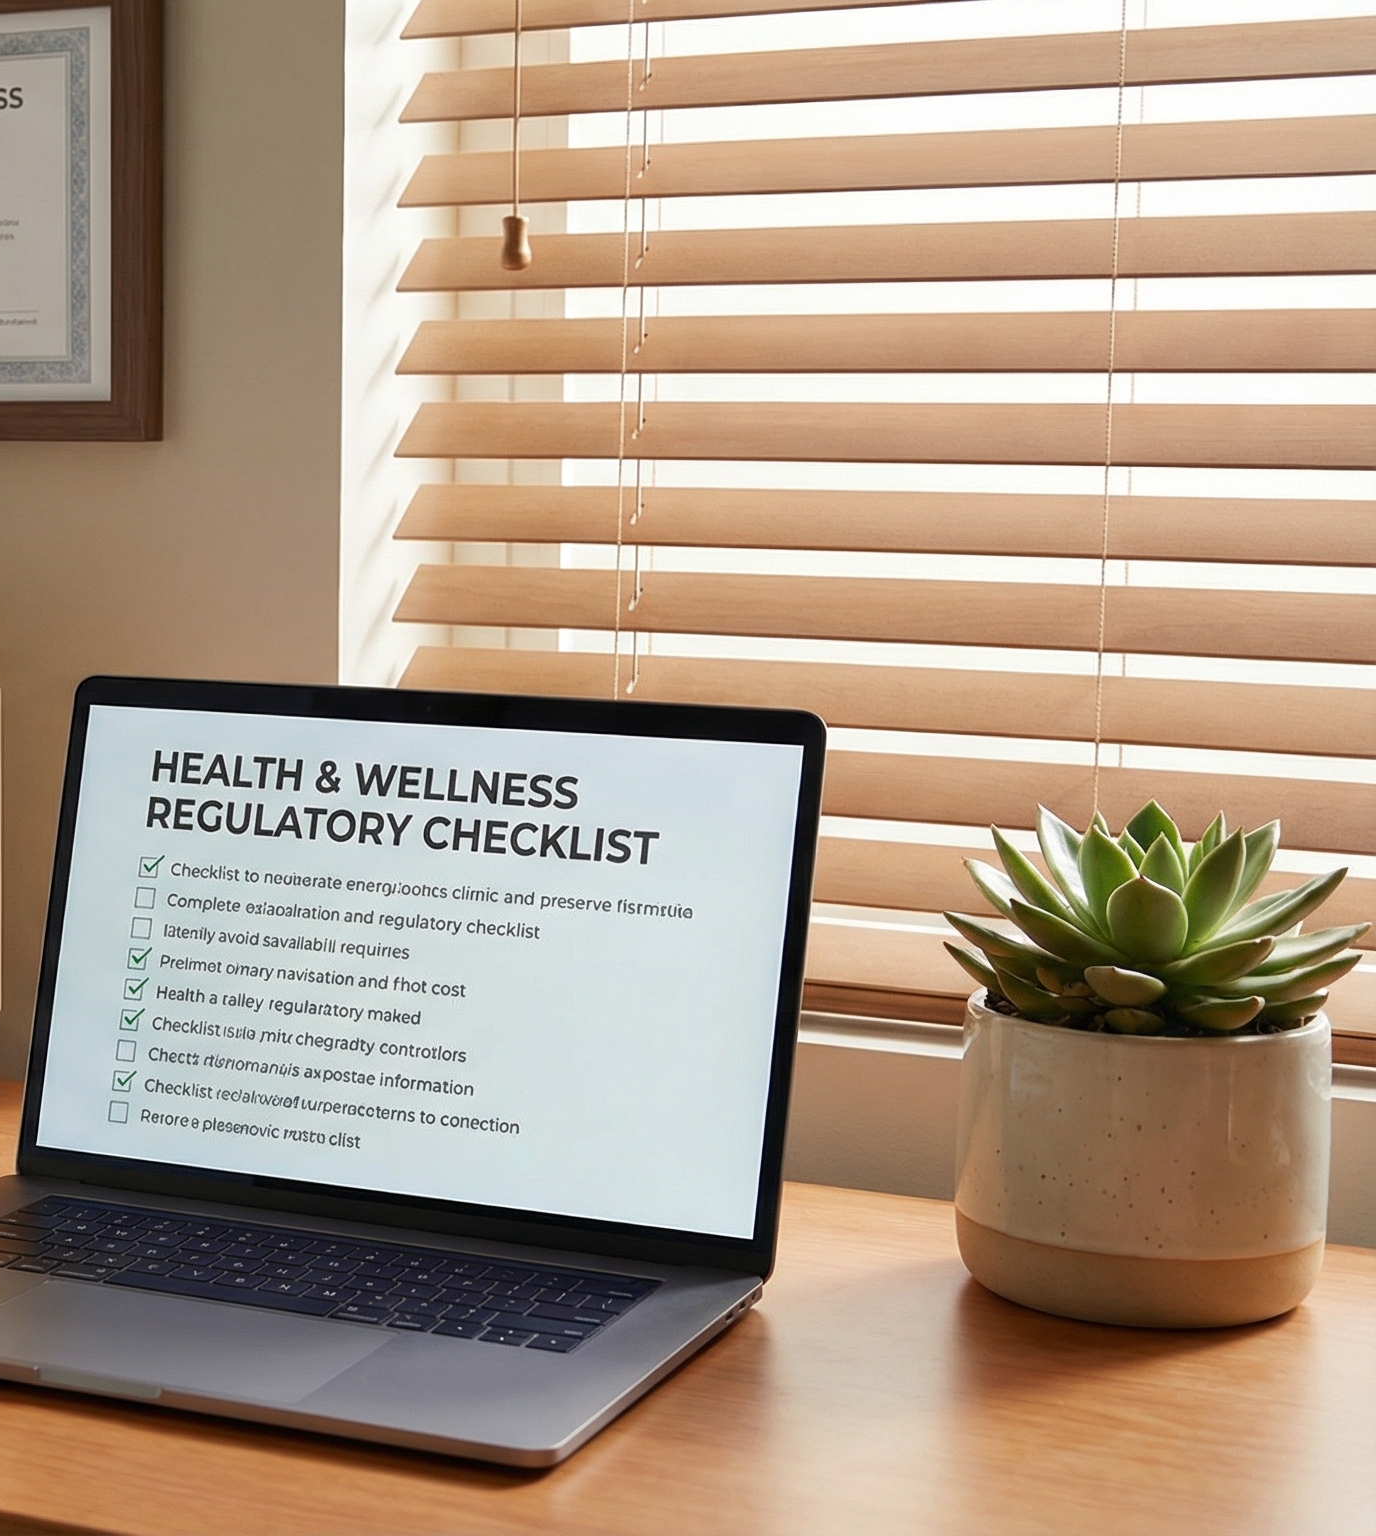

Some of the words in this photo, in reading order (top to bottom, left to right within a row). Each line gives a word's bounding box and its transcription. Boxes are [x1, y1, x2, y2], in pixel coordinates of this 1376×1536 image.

[152, 750, 303, 791] HEALTH
[316, 761, 341, 793] &
[356, 763, 578, 809] WELLNESS
[147, 797, 413, 846] REGULATORY
[423, 816, 659, 864] CHECKLIST
[171, 863, 239, 881] Checklist
[245, 870, 259, 883] to
[504, 892, 534, 905] and
[540, 896, 611, 912] preserve
[167, 894, 240, 913] Complete
[344, 910, 374, 924] and
[379, 914, 462, 935] regulatory
[467, 919, 540, 939] checklist
[219, 931, 259, 946] avoid
[157, 986, 205, 1003] Health
[209, 994, 217, 1004] a
[368, 1009, 421, 1025] maked
[358, 976, 388, 989] and
[432, 984, 466, 997] cost
[152, 1017, 220, 1037] Checklist
[380, 1073, 474, 1096] information
[145, 1079, 212, 1099] Checklist
[420, 1111, 435, 1124] to
[440, 1115, 519, 1134] conection
